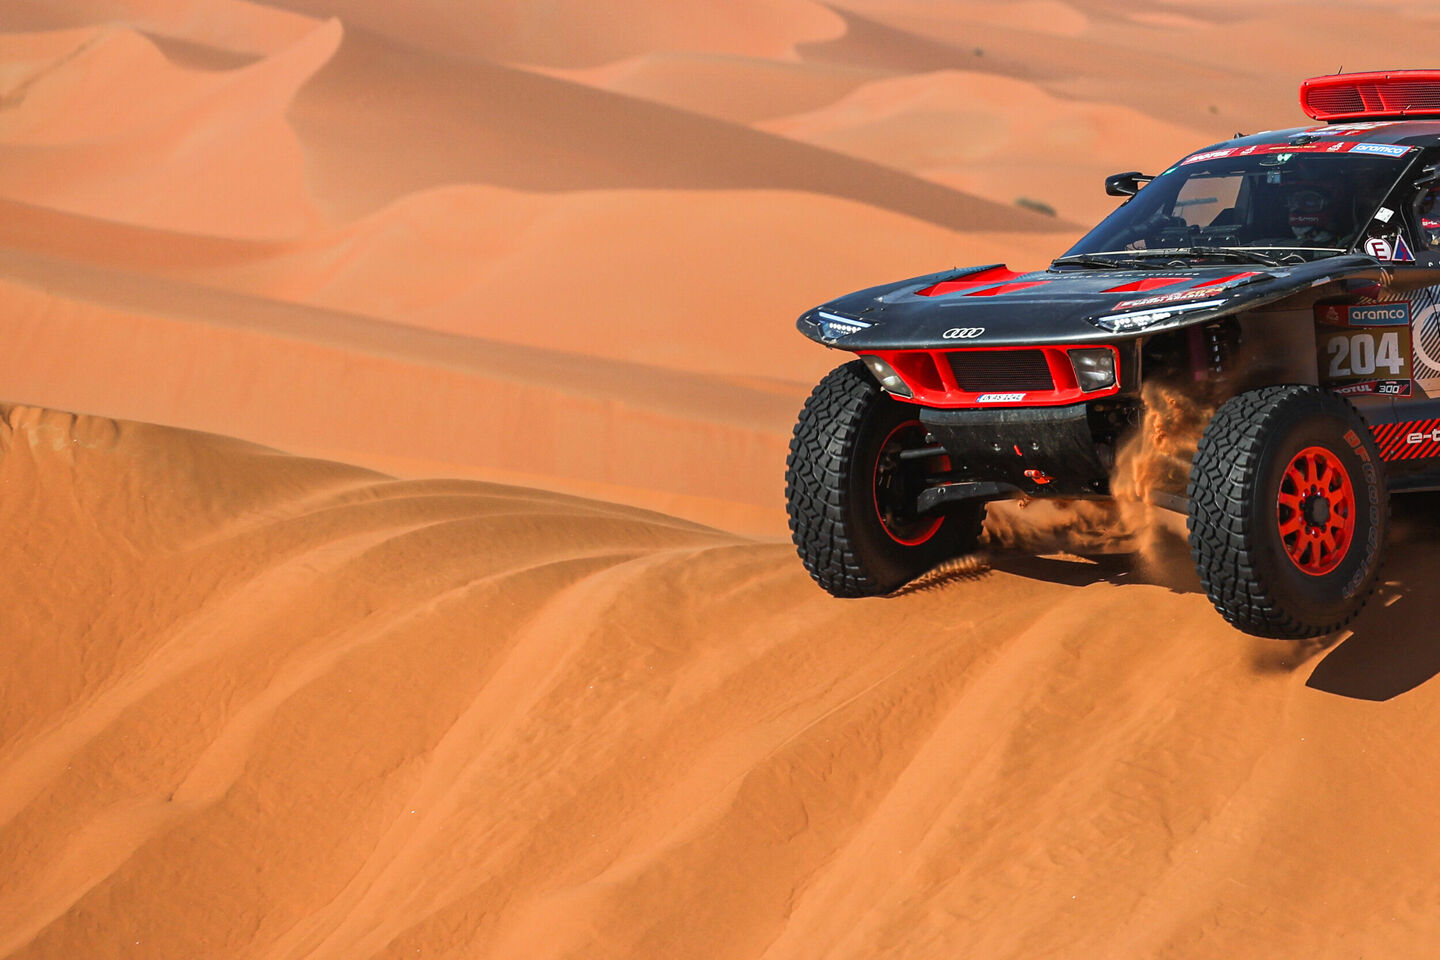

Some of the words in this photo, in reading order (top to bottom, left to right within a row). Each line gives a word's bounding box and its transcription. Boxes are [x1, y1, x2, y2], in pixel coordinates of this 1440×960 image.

[1356, 143, 1403, 154] aramco
[1371, 242, 1388, 259] E
[1351, 309, 1405, 320] aramco
[1327, 332, 1404, 377] 204
[1378, 384, 1409, 394] 300V
